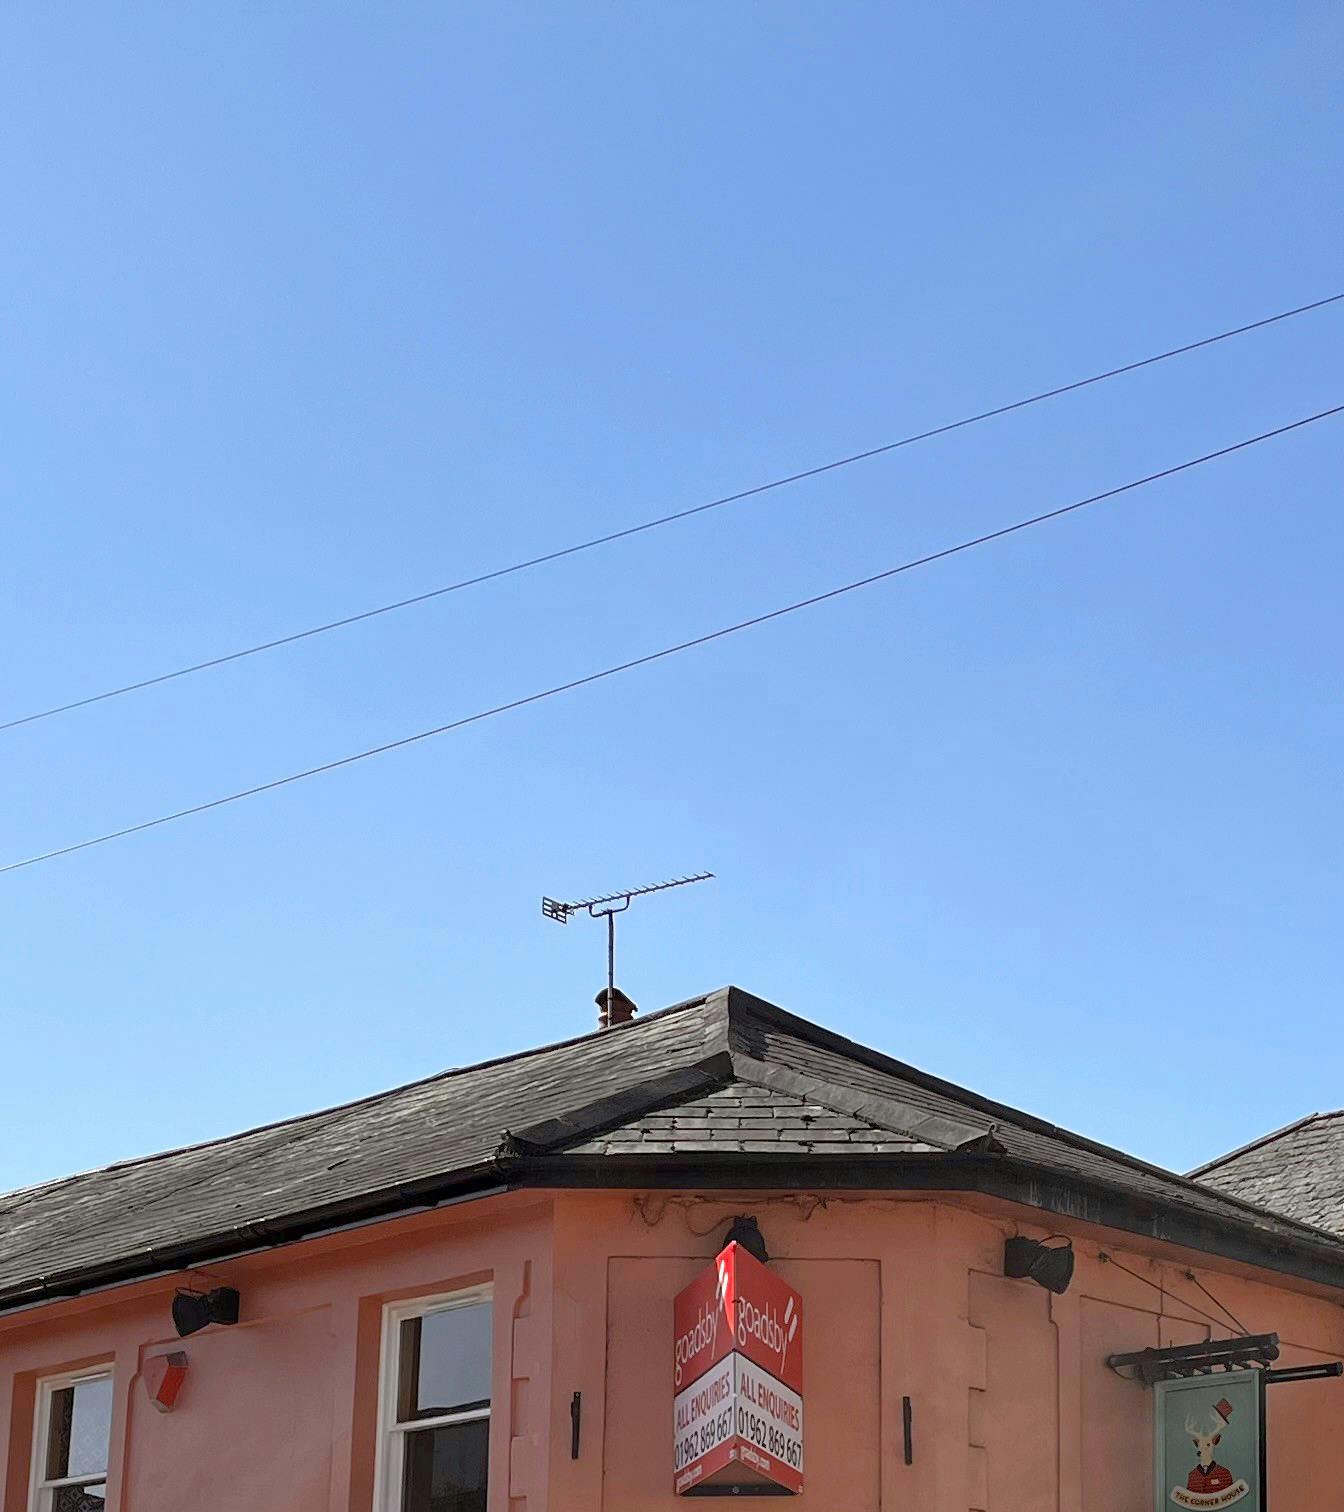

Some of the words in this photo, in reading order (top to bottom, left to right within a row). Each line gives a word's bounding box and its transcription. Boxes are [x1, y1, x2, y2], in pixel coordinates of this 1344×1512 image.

[675, 1301, 719, 1386] goadsby
[737, 1295, 788, 1374] goadsby
[677, 1404, 690, 1430] ALL
[691, 1371, 731, 1421] ENQUIRIES
[740, 1372, 756, 1404] ALL
[758, 1382, 800, 1432] ENQUIRIES
[675, 1431, 699, 1470] 01962
[700, 1418, 715, 1453] 869
[717, 1406, 733, 1441] 667
[738, 1406, 767, 1448] 01962
[768, 1425, 785, 1458] 869
[786, 1438, 802, 1469] 667
[1175, 1491, 1188, 1504] THE
[1190, 1498, 1219, 1507] CORNER
[1221, 1485, 1245, 1503] HOUSE
